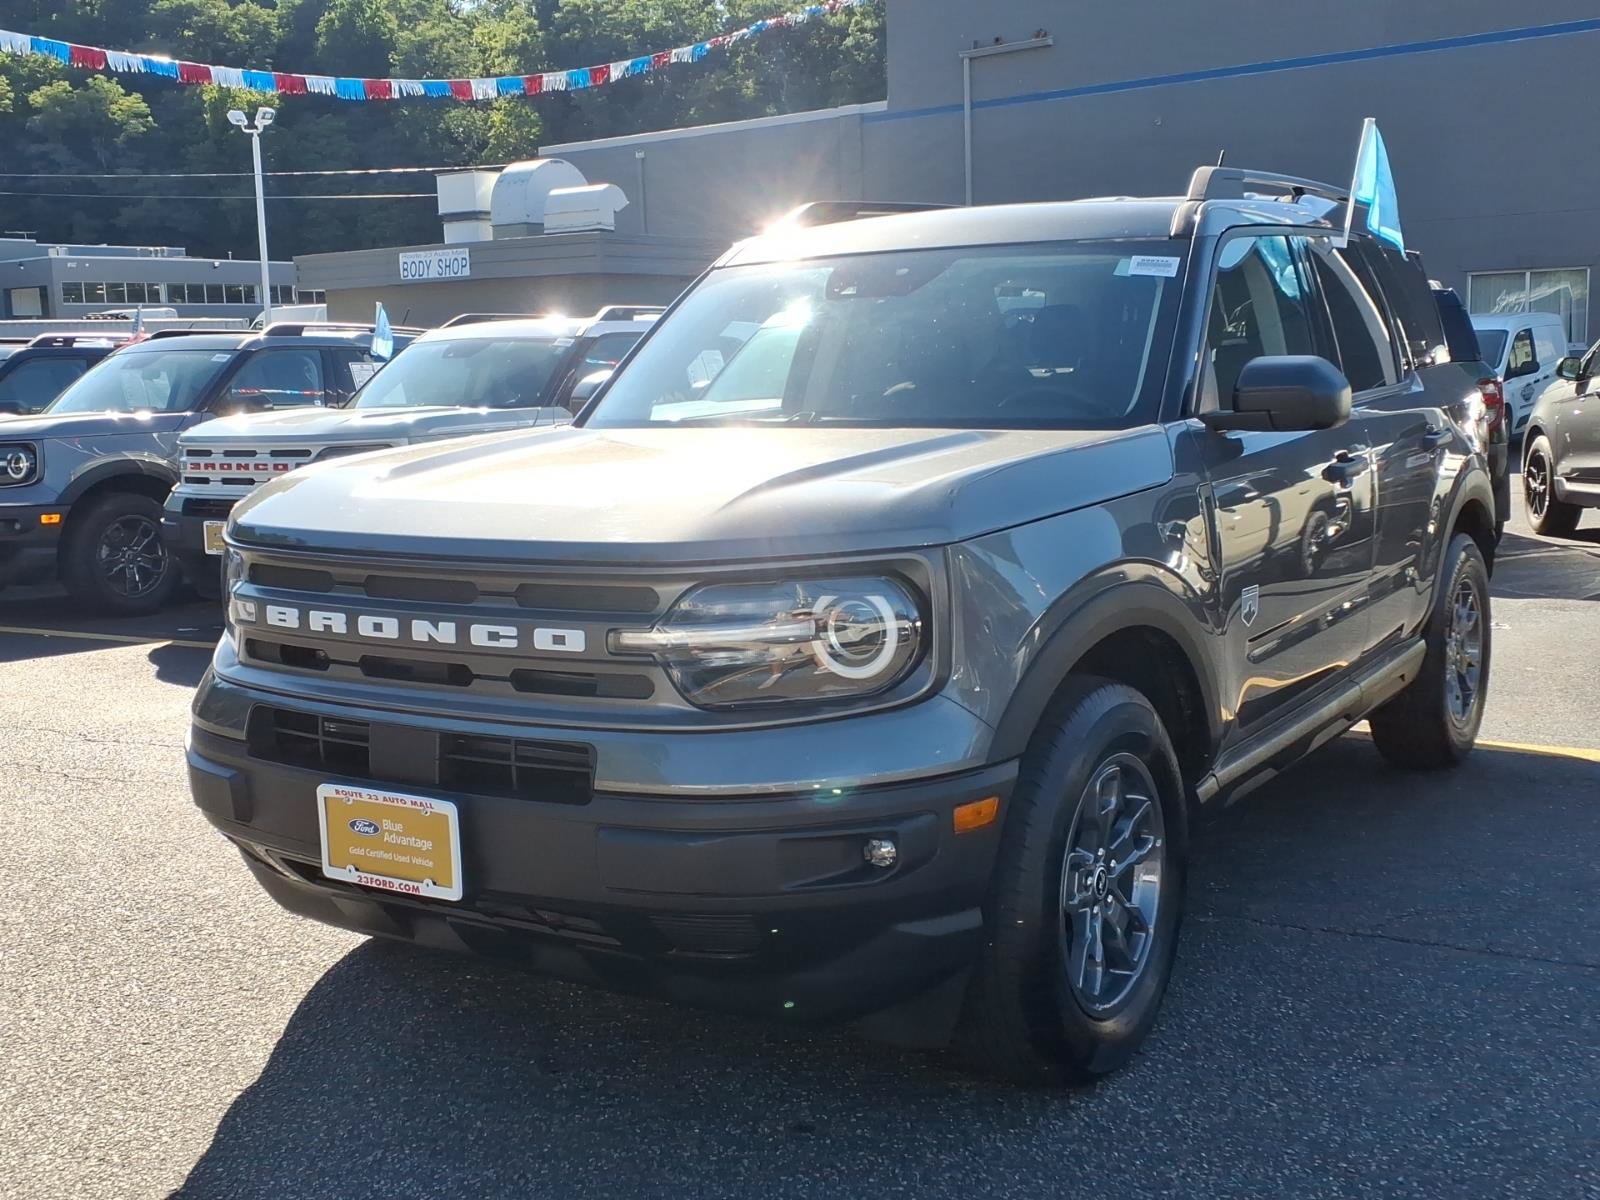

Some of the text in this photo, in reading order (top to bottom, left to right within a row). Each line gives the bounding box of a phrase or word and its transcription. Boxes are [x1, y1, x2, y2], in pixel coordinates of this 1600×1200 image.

[402, 257, 468, 278] BODY SHOP
[266, 604, 586, 653] BRONCO
[334, 788, 435, 810] ROUTE 23 AUTO MALL
[354, 819, 375, 834] Ford
[382, 819, 403, 833] Blue
[383, 832, 433, 851] Advantage
[349, 846, 434, 868] Gold Certified Used Vehicle
[356, 875, 421, 893] 23FORD.COM
